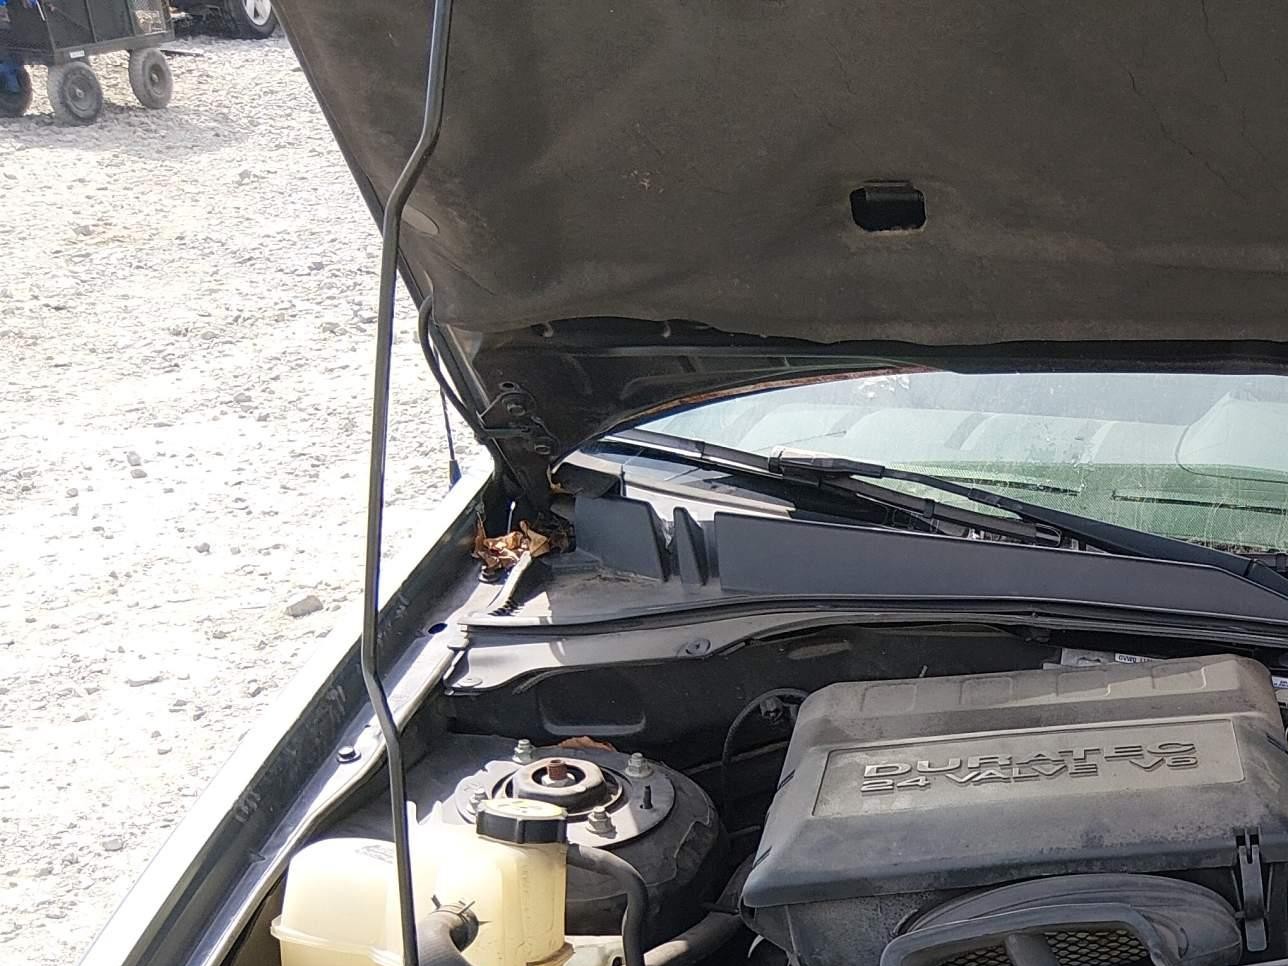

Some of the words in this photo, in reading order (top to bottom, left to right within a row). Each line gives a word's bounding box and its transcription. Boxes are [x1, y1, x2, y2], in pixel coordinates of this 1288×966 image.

[861, 775, 931, 794] 24
[946, 763, 1099, 785] VALVE
[1129, 755, 1200, 773] V6
[863, 742, 1197, 778] DURATEC
